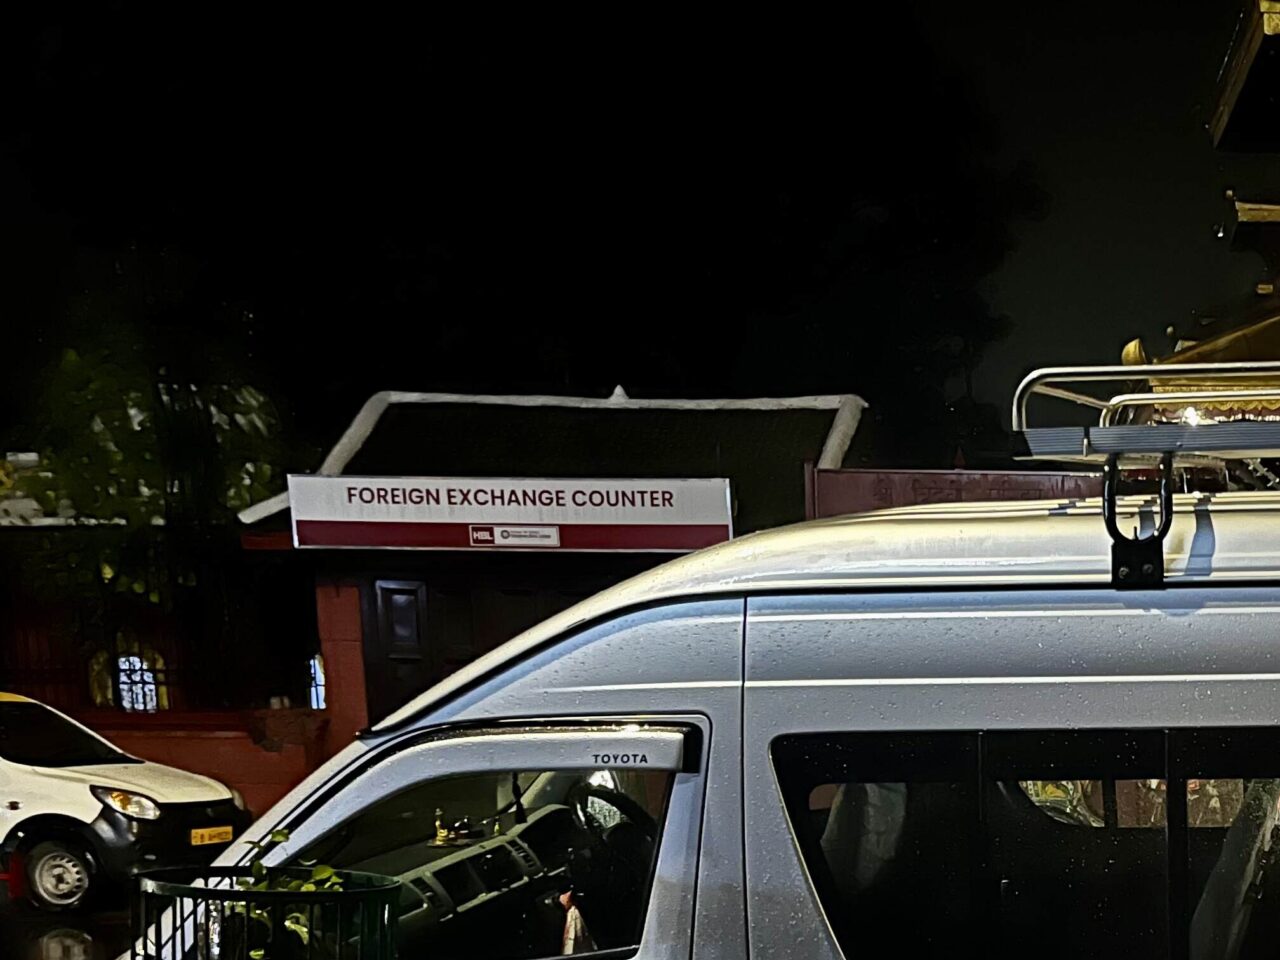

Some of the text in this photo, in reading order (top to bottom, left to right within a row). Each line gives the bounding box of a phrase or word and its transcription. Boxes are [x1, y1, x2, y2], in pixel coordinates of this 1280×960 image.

[346, 486, 674, 508] FOREIGN EXCHANGE COUNTER
[592, 753, 649, 764] TOYOTA
